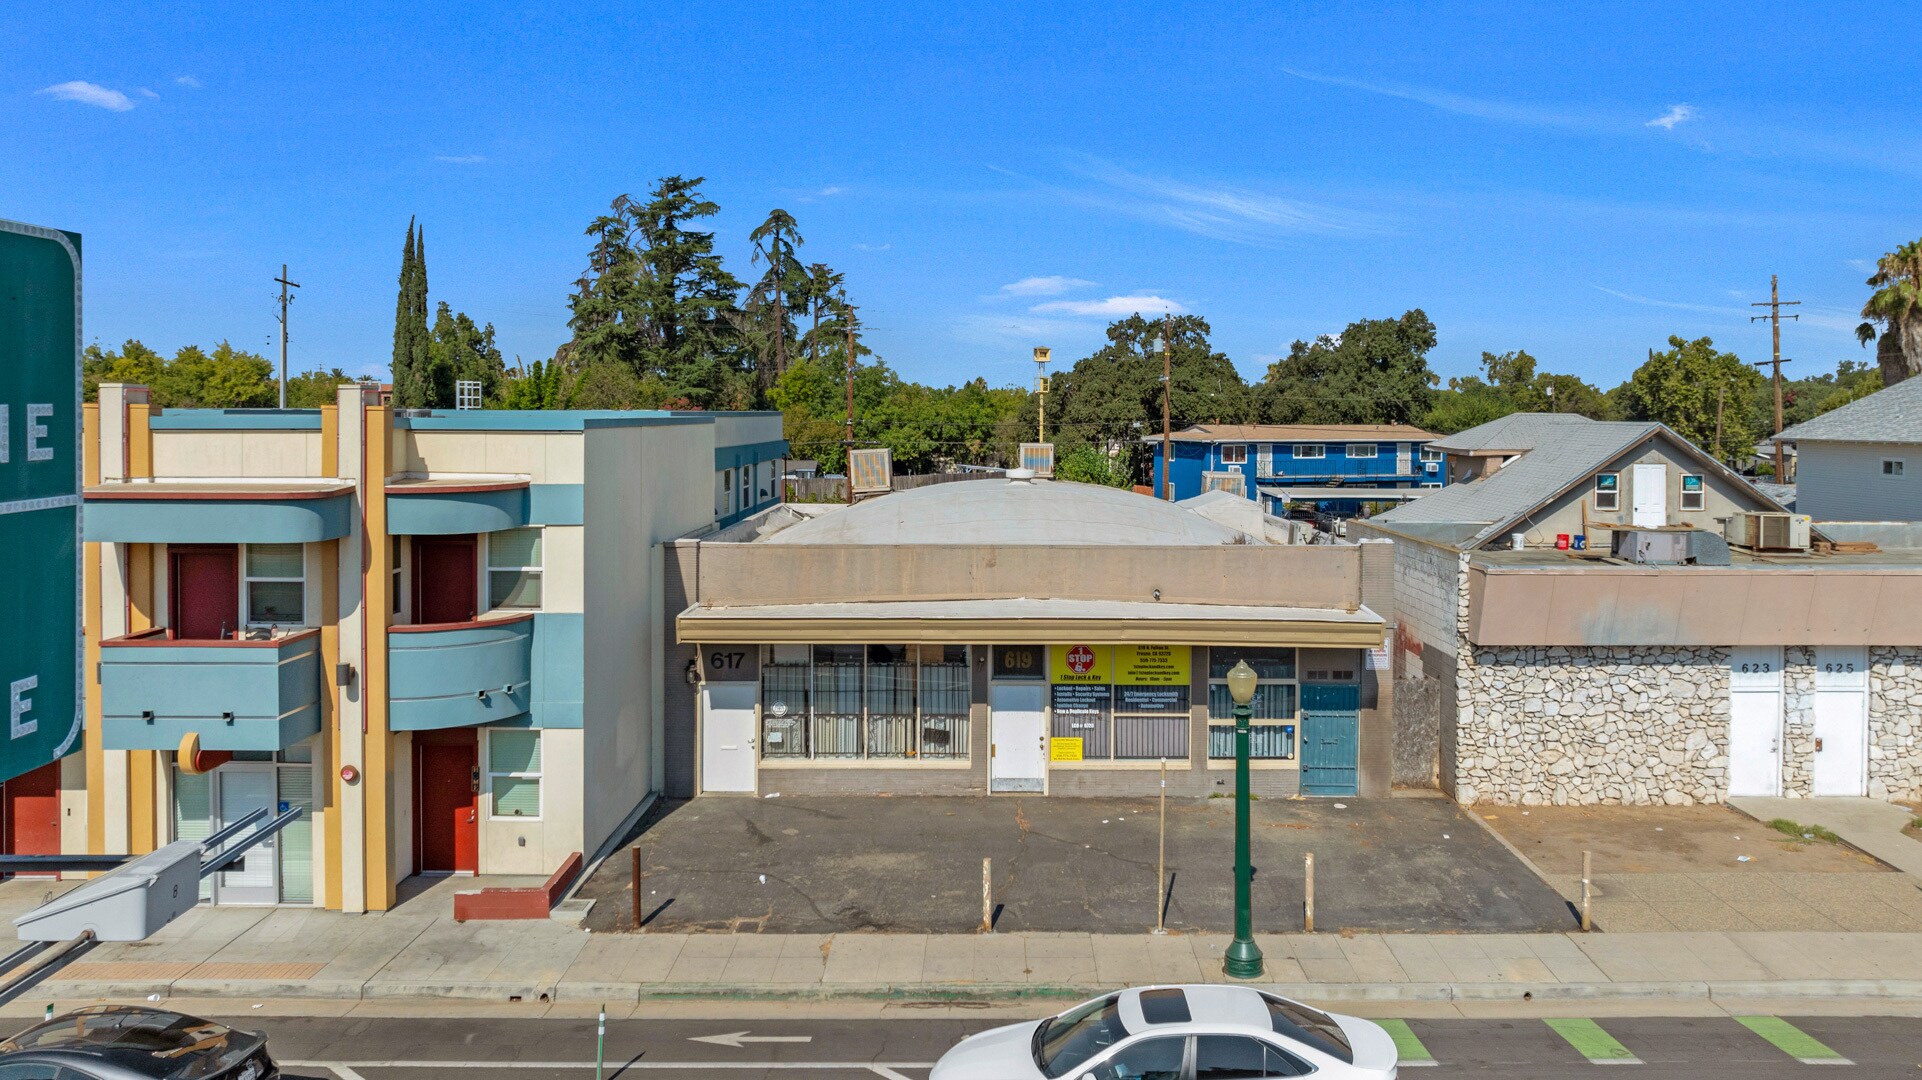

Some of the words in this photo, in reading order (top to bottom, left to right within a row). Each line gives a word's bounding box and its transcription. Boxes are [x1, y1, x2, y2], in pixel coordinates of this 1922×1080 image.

[711, 652, 745, 669] 617
[1005, 651, 1033, 668] 619
[1068, 654, 1093, 662] STOP
[1741, 663, 1770, 673] 623
[1825, 663, 1854, 673] 625
[172, 884, 179, 898] 8
